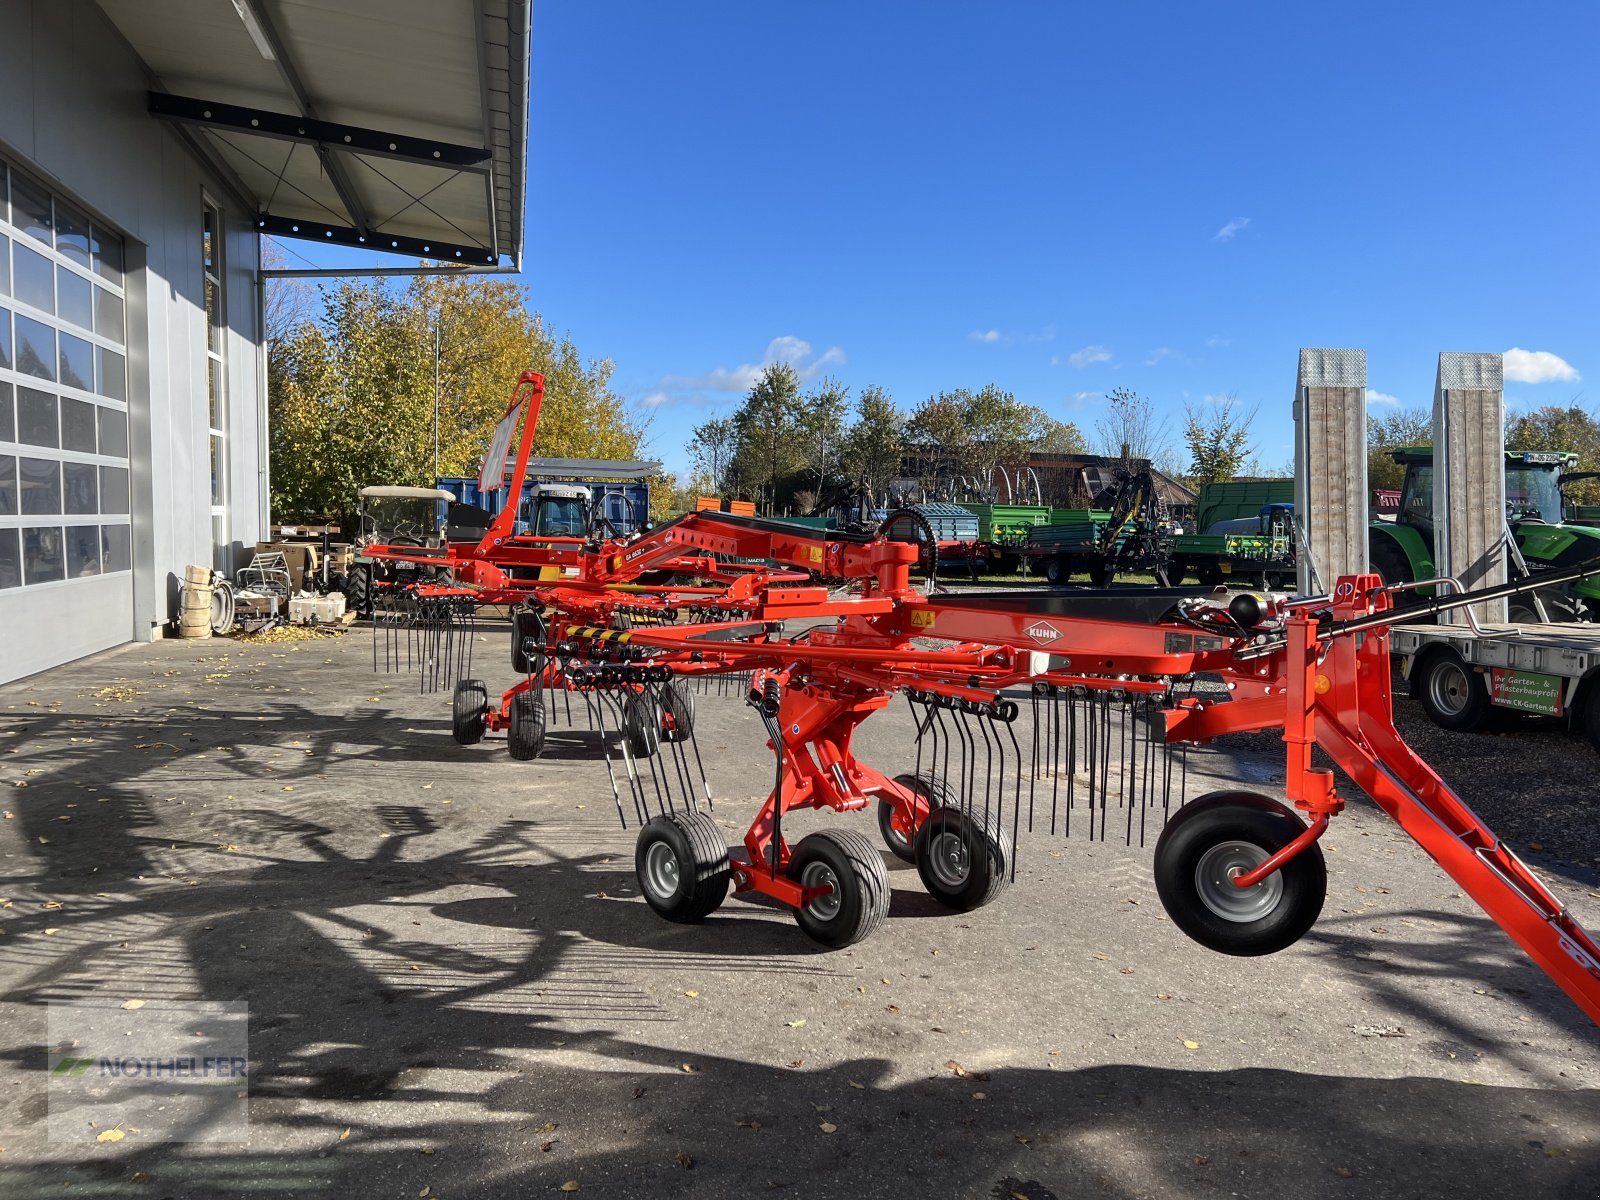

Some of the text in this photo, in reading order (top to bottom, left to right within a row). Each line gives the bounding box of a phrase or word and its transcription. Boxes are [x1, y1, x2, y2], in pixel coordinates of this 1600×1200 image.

[1029, 627, 1058, 639] KUHN
[1494, 674, 1551, 688] Ihr Garten- &
[1494, 683, 1559, 698] Pflasterbauprofi!
[1494, 697, 1559, 713] www.CK-Garten.de
